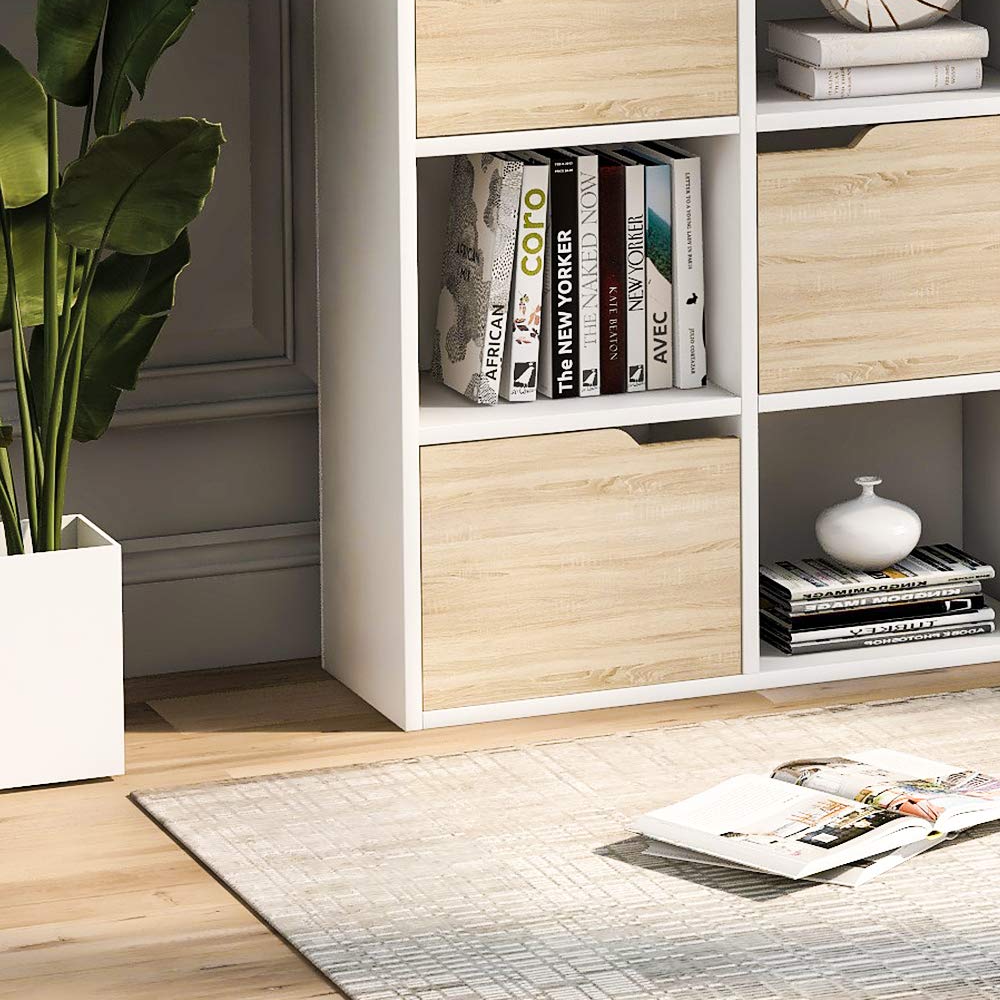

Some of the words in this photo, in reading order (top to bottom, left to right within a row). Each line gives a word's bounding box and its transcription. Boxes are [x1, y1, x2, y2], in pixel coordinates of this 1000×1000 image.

[580, 171, 598, 225] NOW
[521, 188, 546, 276] coro
[628, 214, 644, 275] YORKER
[557, 229, 573, 307] YORKER
[582, 232, 598, 309] NAKED
[628, 276, 644, 312] NEW
[608, 286, 618, 315] KATE
[485, 304, 504, 380] AFRICAN
[557, 311, 573, 355] NEW
[584, 313, 597, 348] THE
[608, 320, 618, 361] BEATON
[653, 311, 668, 364] AVEC
[557, 359, 573, 394] The
